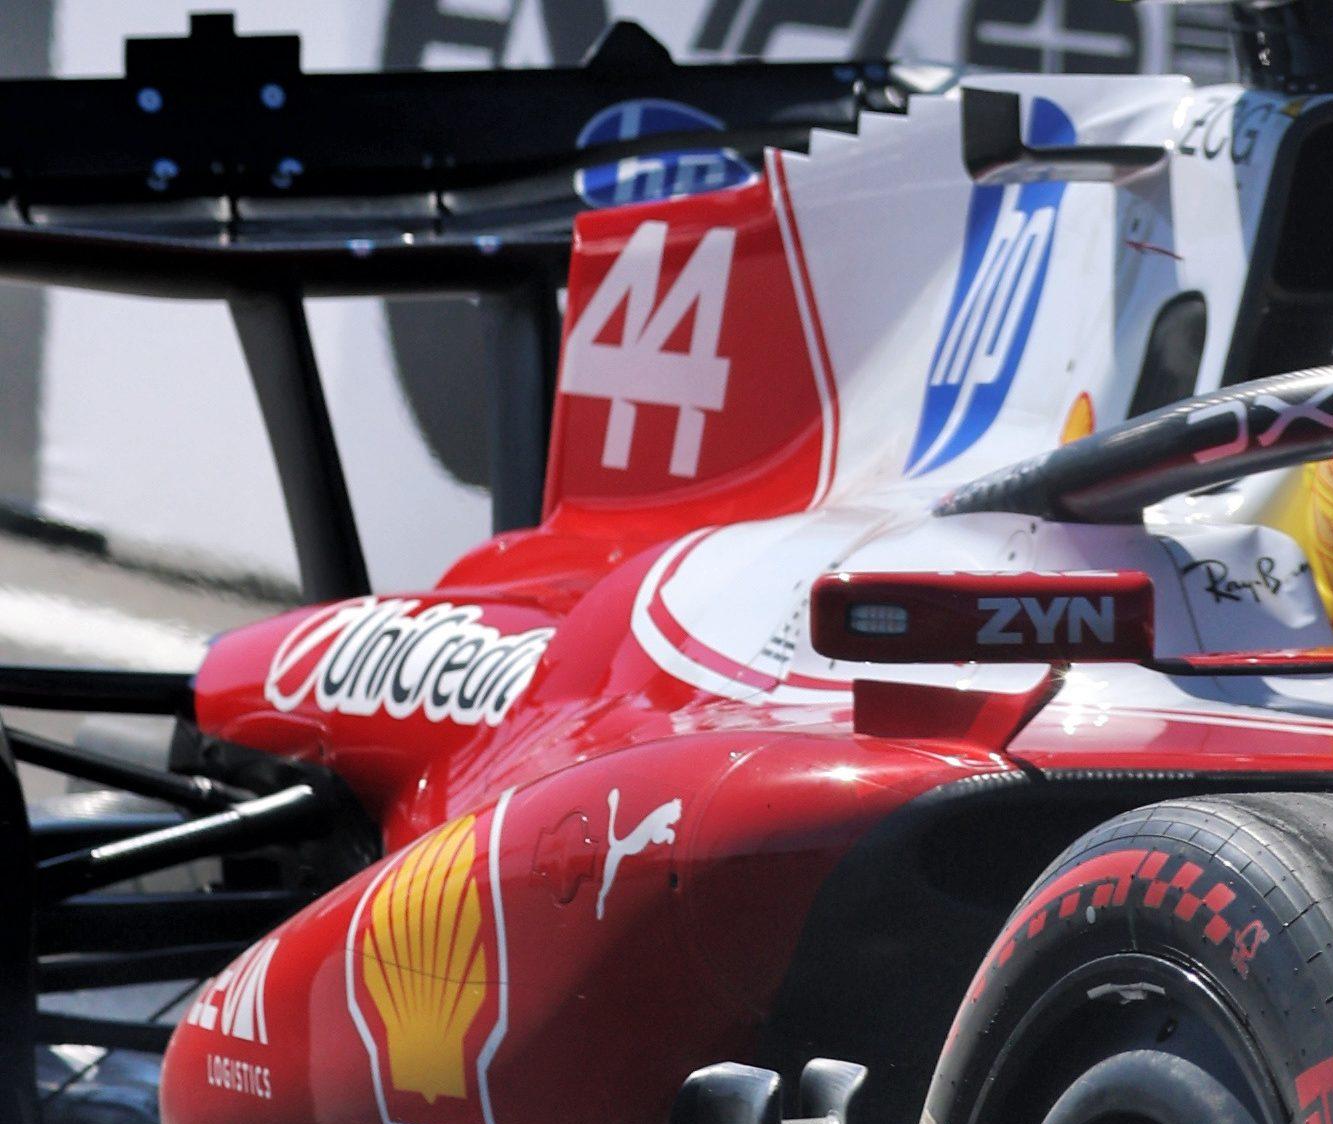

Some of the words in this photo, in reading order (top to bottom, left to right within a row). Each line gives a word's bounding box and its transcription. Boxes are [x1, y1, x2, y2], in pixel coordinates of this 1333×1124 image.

[559, 219, 737, 479] 44
[321, 603, 556, 714] UniCredit
[976, 596, 1116, 645] ZYN
[207, 1053, 273, 1100] LOGISTICS
